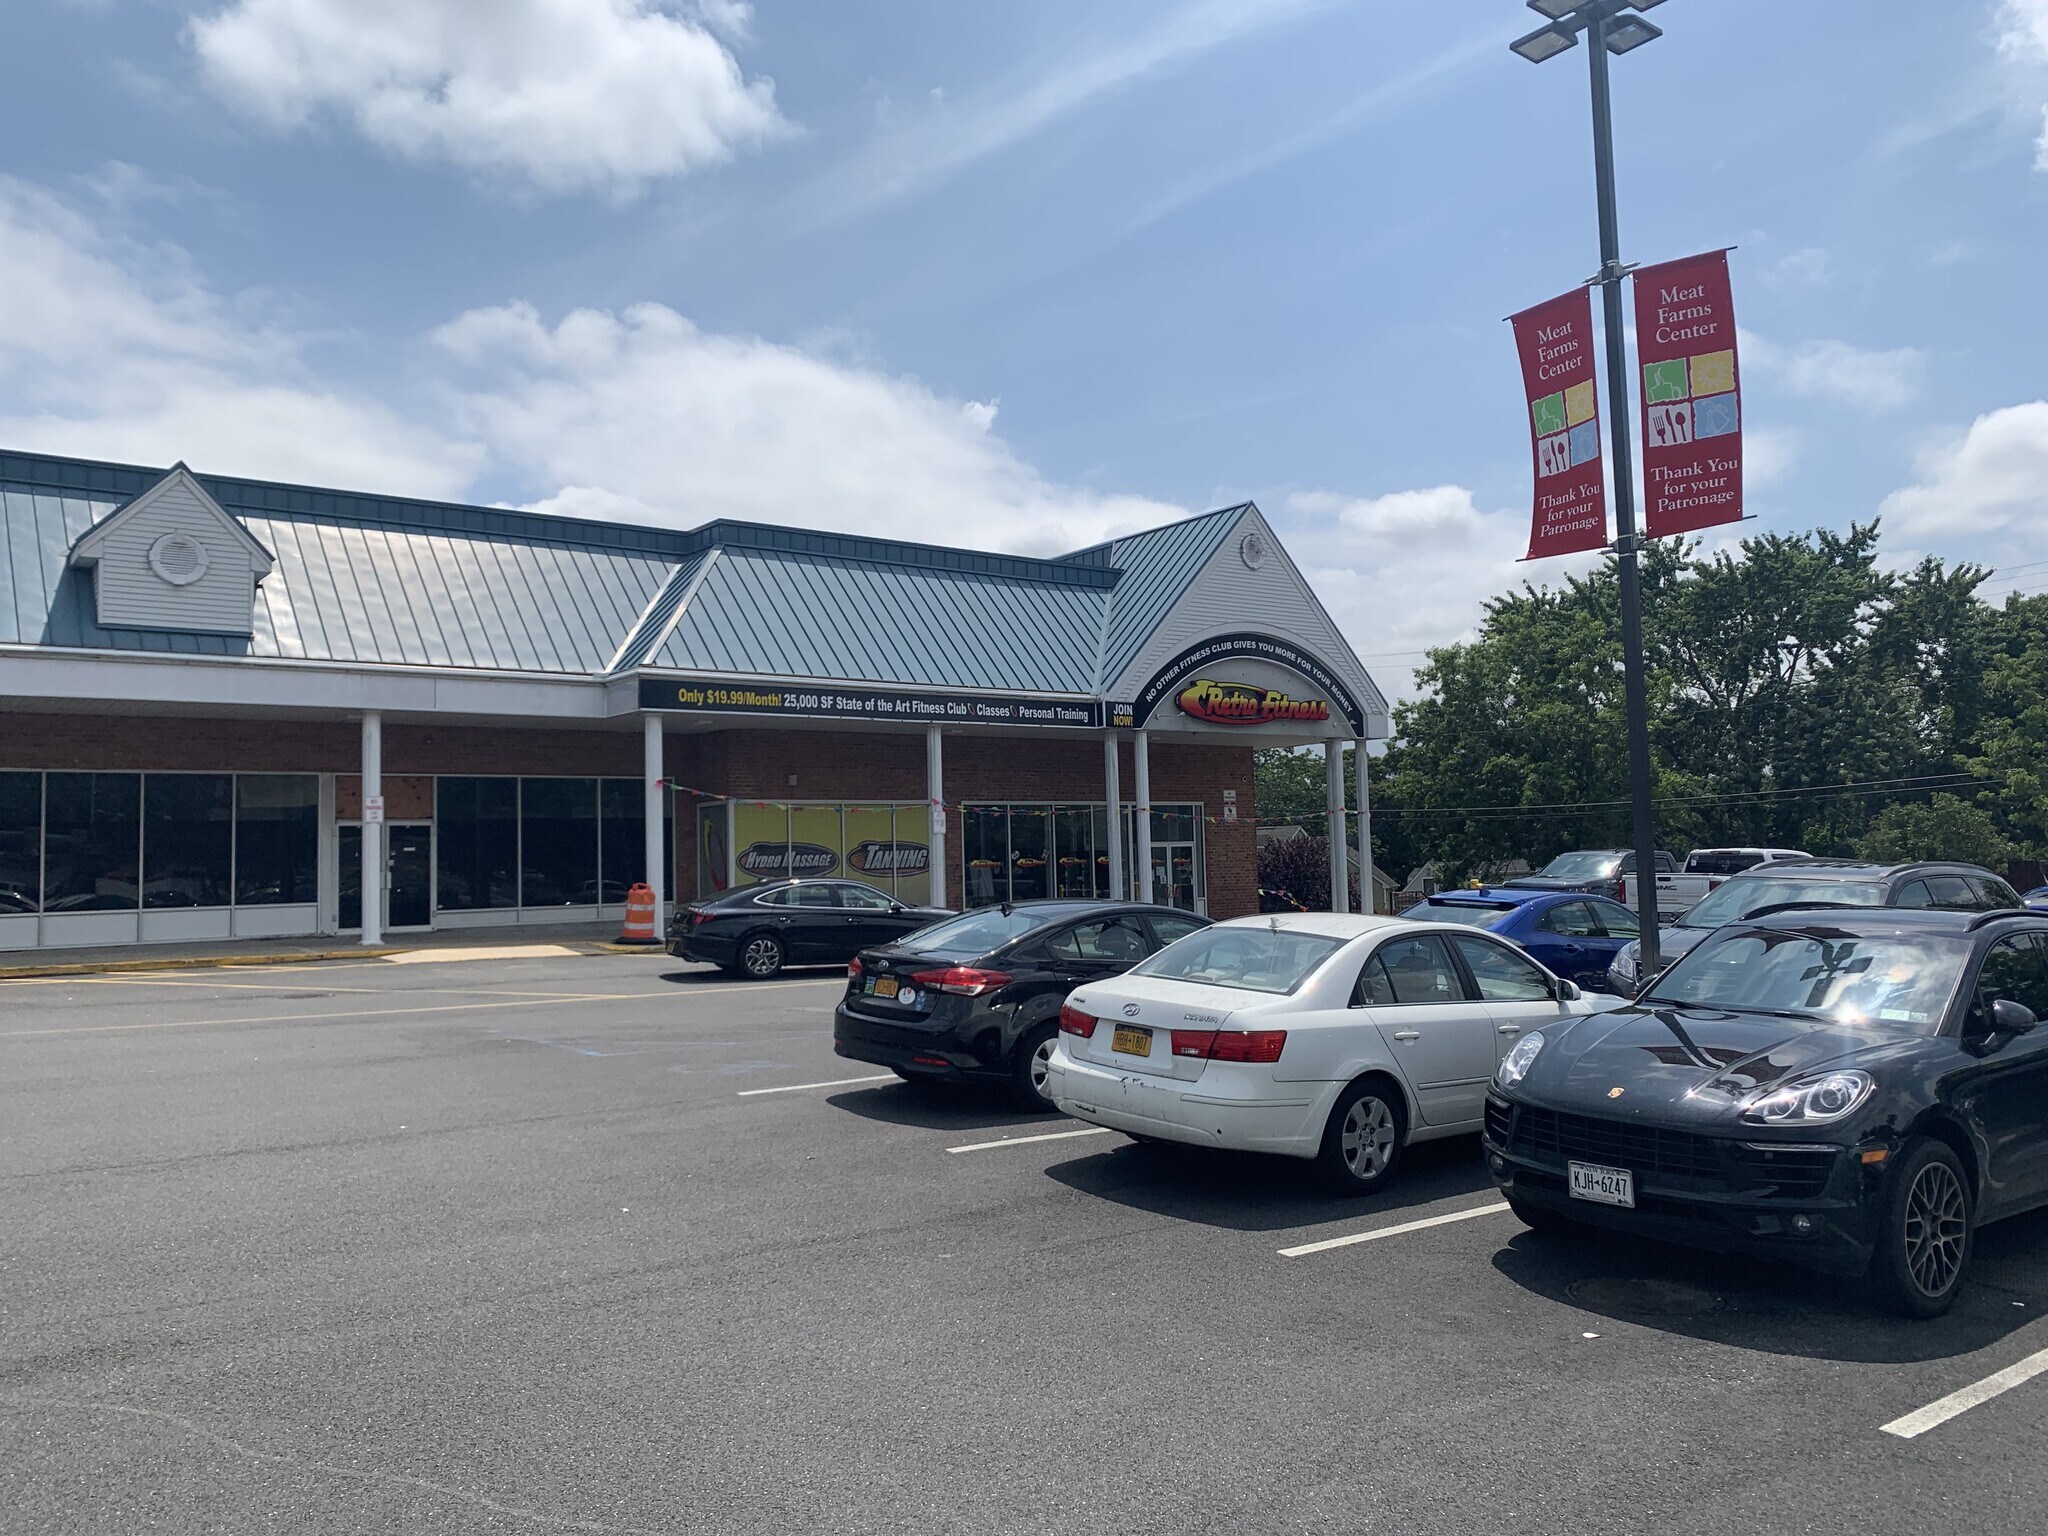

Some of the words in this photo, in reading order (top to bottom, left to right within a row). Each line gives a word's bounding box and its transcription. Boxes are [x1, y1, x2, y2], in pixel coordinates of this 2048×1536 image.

[1659, 283, 1705, 305] Meat
[1657, 303, 1712, 325] Farms
[1536, 321, 1573, 345] Meat
[1655, 322, 1718, 344] Center
[1537, 338, 1579, 364] Farms
[1538, 354, 1583, 381] Center
[1650, 461, 1703, 482] Thank
[1706, 457, 1739, 473] You
[1539, 488, 1577, 510] Thank
[1579, 483, 1600, 498] You
[1664, 482, 1687, 496] for
[1690, 475, 1727, 495] your
[1547, 508, 1566, 523] for
[1566, 501, 1593, 520] your
[1657, 491, 1735, 513] Patronage
[1539, 515, 1600, 538] Patronage
[1145, 688, 1157, 703] NO
[1156, 665, 1180, 690] OTHER
[1179, 647, 1211, 671] FITNESS
[1212, 641, 1232, 653] CLUB
[1233, 640, 1256, 649] GIVES
[1258, 642, 1274, 652] YOU
[1275, 646, 1297, 662] MORE
[1296, 657, 1312, 672] FOR
[1312, 666, 1331, 688] YOUR
[1331, 684, 1354, 713] MONEY
[678, 688, 703, 706] Only
[706, 690, 782, 707] $19.99/Month!
[784, 693, 818, 710] 25,000
[820, 696, 833, 709] SF
[836, 697, 862, 711] State
[864, 698, 875, 711] of
[877, 700, 893, 712] the
[895, 702, 910, 713] Art
[912, 701, 945, 714] Fitness
[947, 702, 967, 716] Club
[976, 703, 1010, 717] Classes
[1019, 705, 1055, 719] Personal
[1056, 707, 1089, 722] Training
[1113, 704, 1133, 715] JOIN
[1206, 686, 1258, 716] Retro
[1262, 691, 1330, 721] Fitness
[1113, 716, 1133, 726] NOW!
[745, 852, 780, 869] HYDRO
[782, 851, 833, 868] MASSAGE
[863, 845, 928, 869] TANNING
